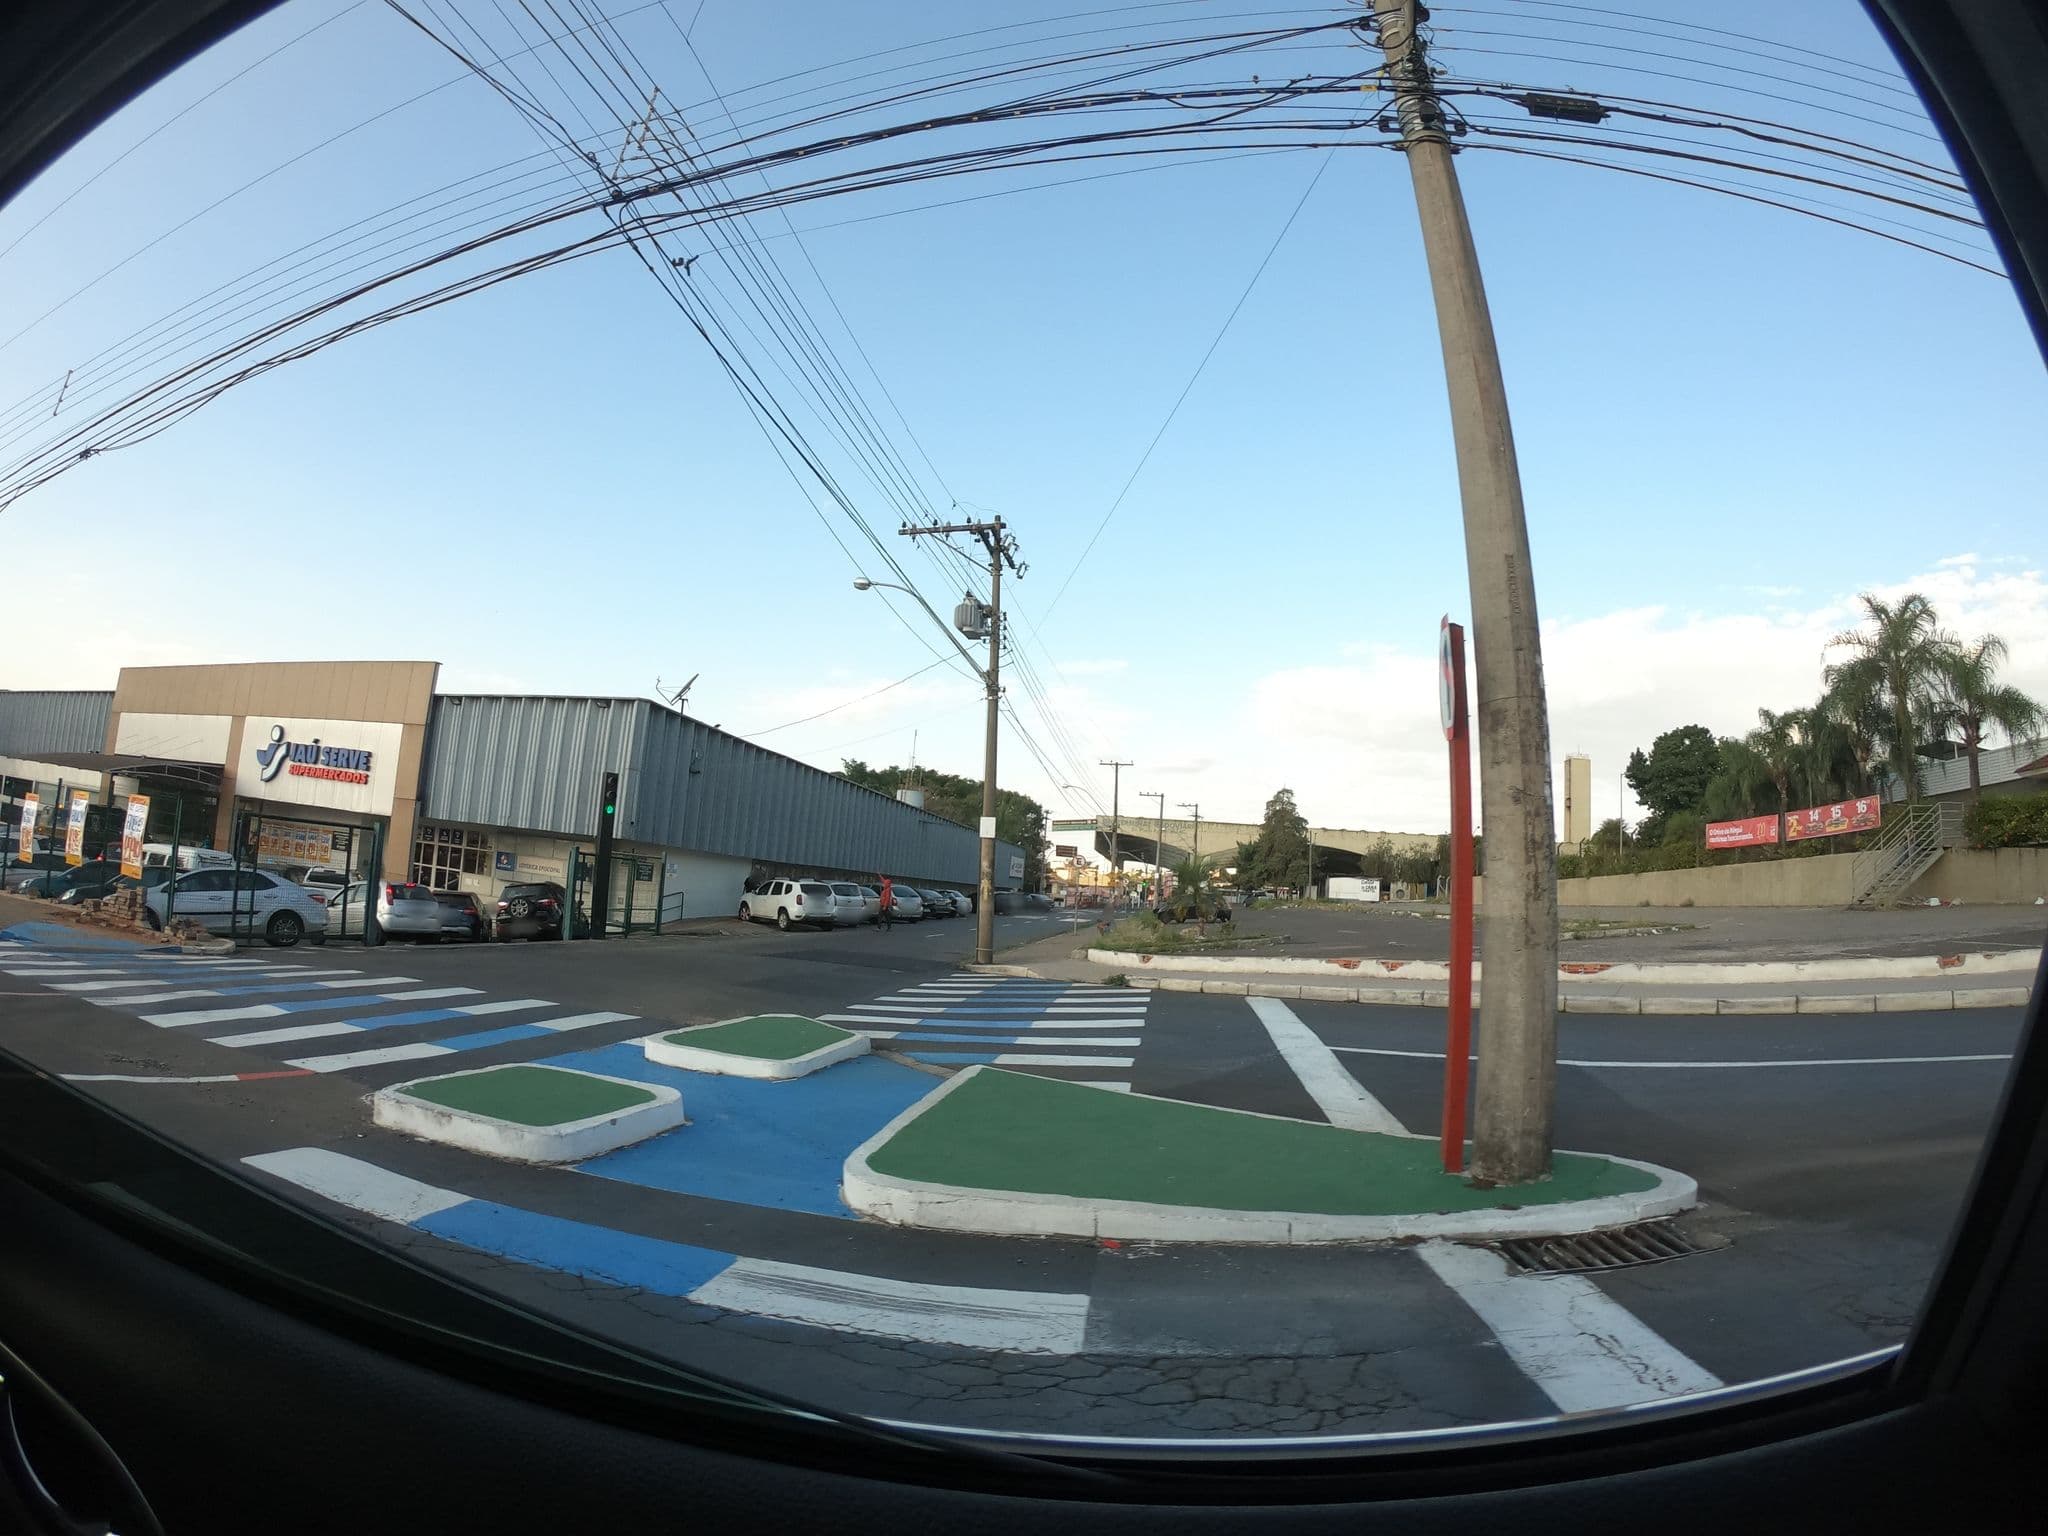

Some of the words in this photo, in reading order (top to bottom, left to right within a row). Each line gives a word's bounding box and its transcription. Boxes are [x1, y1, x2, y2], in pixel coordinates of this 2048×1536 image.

[321, 747, 372, 771] SERVE
[288, 764, 369, 784] SUPERMERCADOS
[1856, 800, 1867, 813] 16
[1809, 809, 1819, 822] 14
